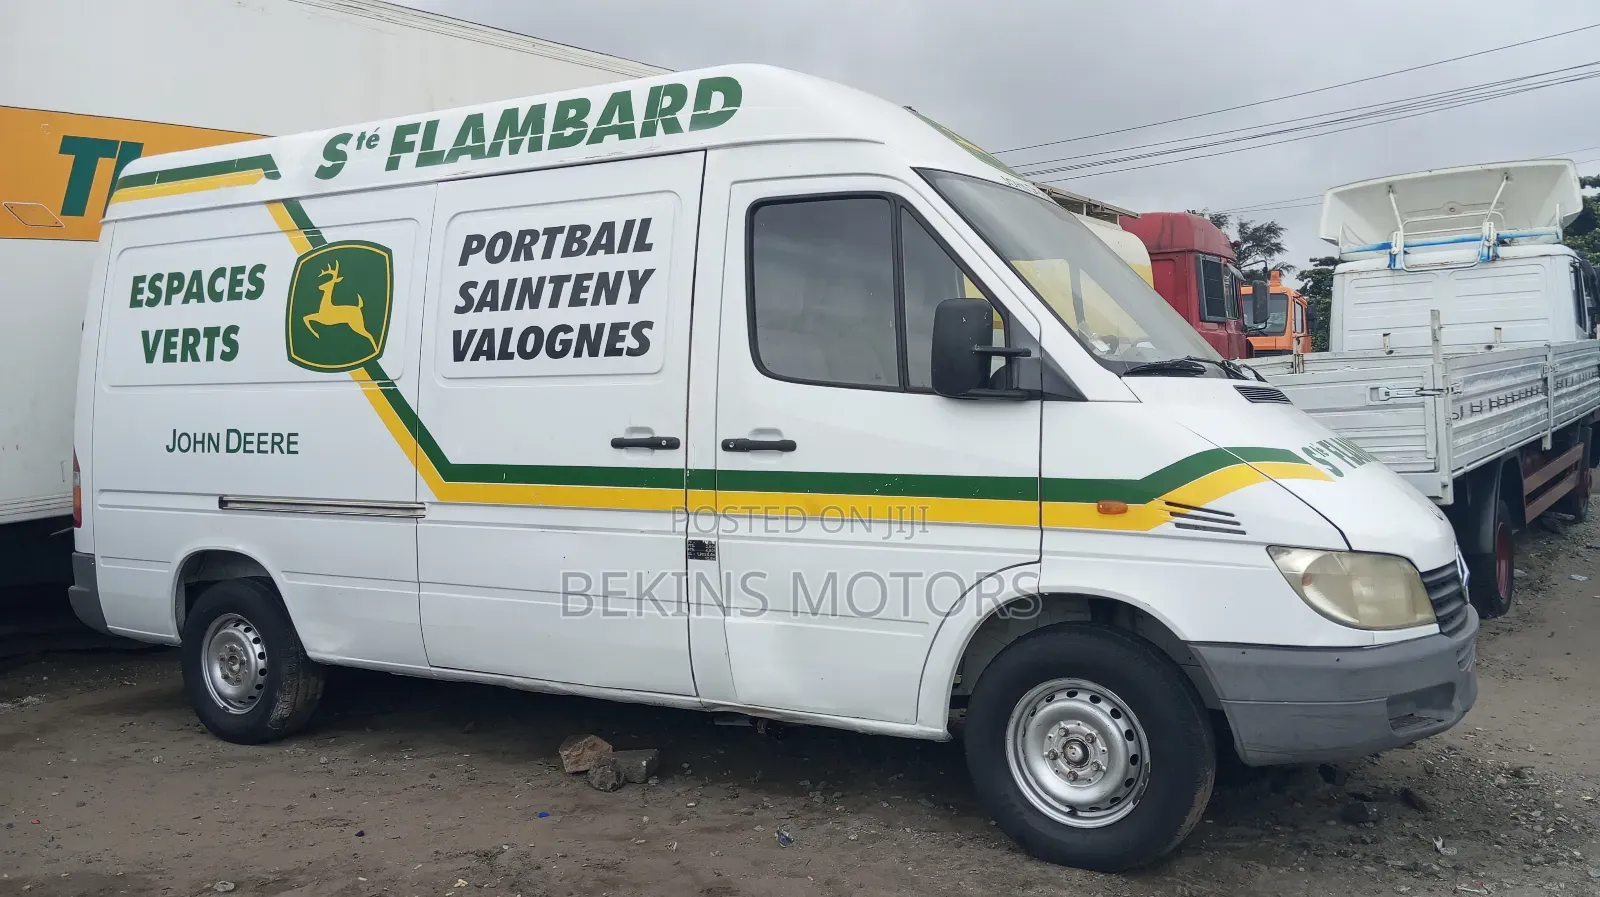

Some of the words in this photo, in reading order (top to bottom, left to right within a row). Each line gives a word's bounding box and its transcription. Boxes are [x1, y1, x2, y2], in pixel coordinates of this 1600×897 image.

[314, 128, 380, 180] Sté
[386, 76, 743, 171] FLAMBARD
[458, 217, 654, 267] PORTBAIL
[129, 263, 267, 309] ESPACES
[454, 268, 657, 315] SAINTENY
[141, 324, 241, 365] VERTS
[452, 320, 655, 363] VALOGNES
[165, 428, 221, 454] JOHN
[225, 428, 300, 455] DEERE
